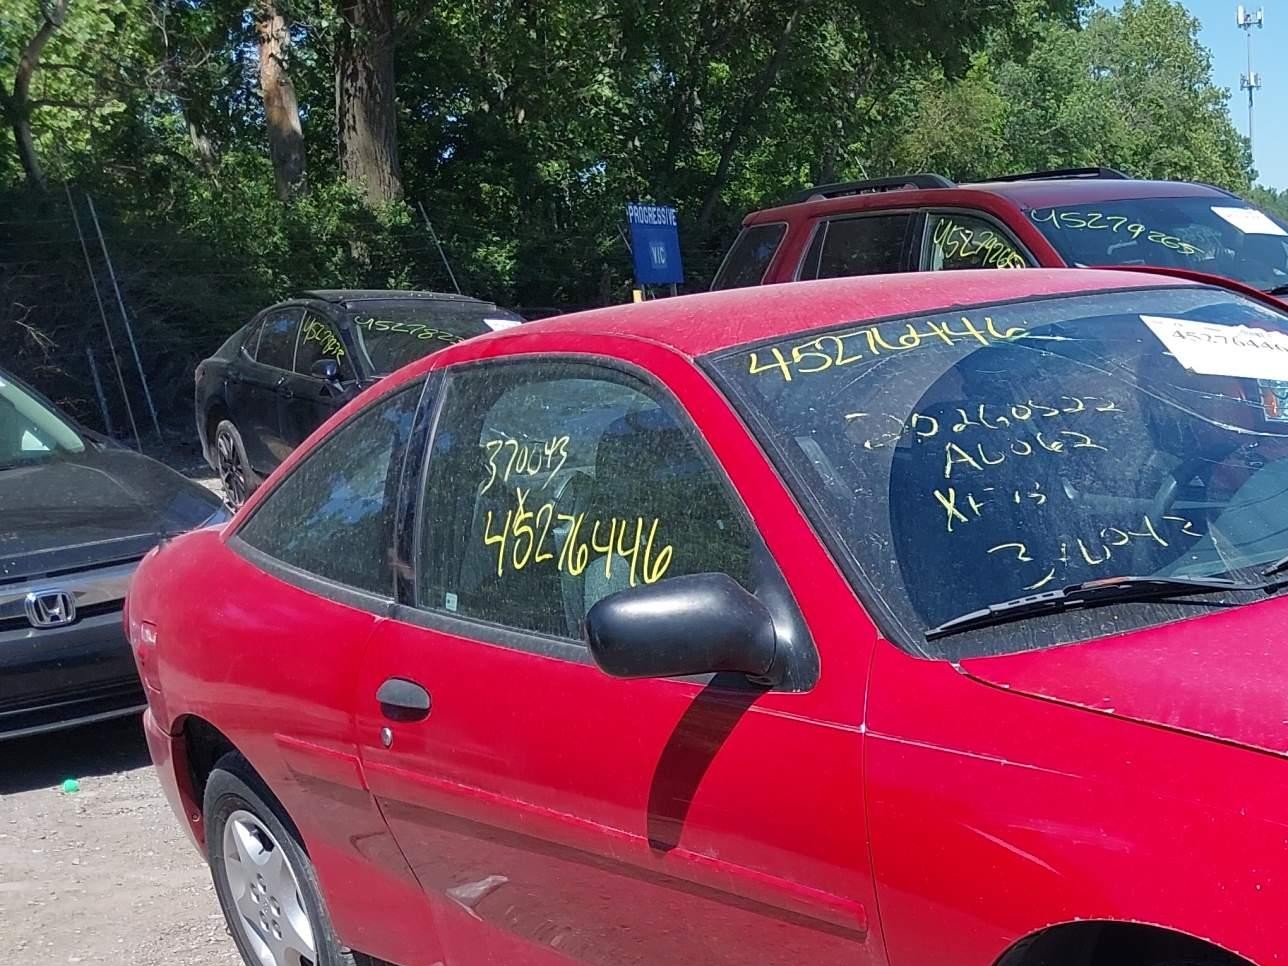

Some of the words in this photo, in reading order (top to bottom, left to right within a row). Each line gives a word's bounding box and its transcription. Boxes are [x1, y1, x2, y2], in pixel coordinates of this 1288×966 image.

[628, 205, 677, 226] PROGRESSIVE
[749, 316, 1029, 381] 45276446
[484, 503, 673, 588] 45276446
